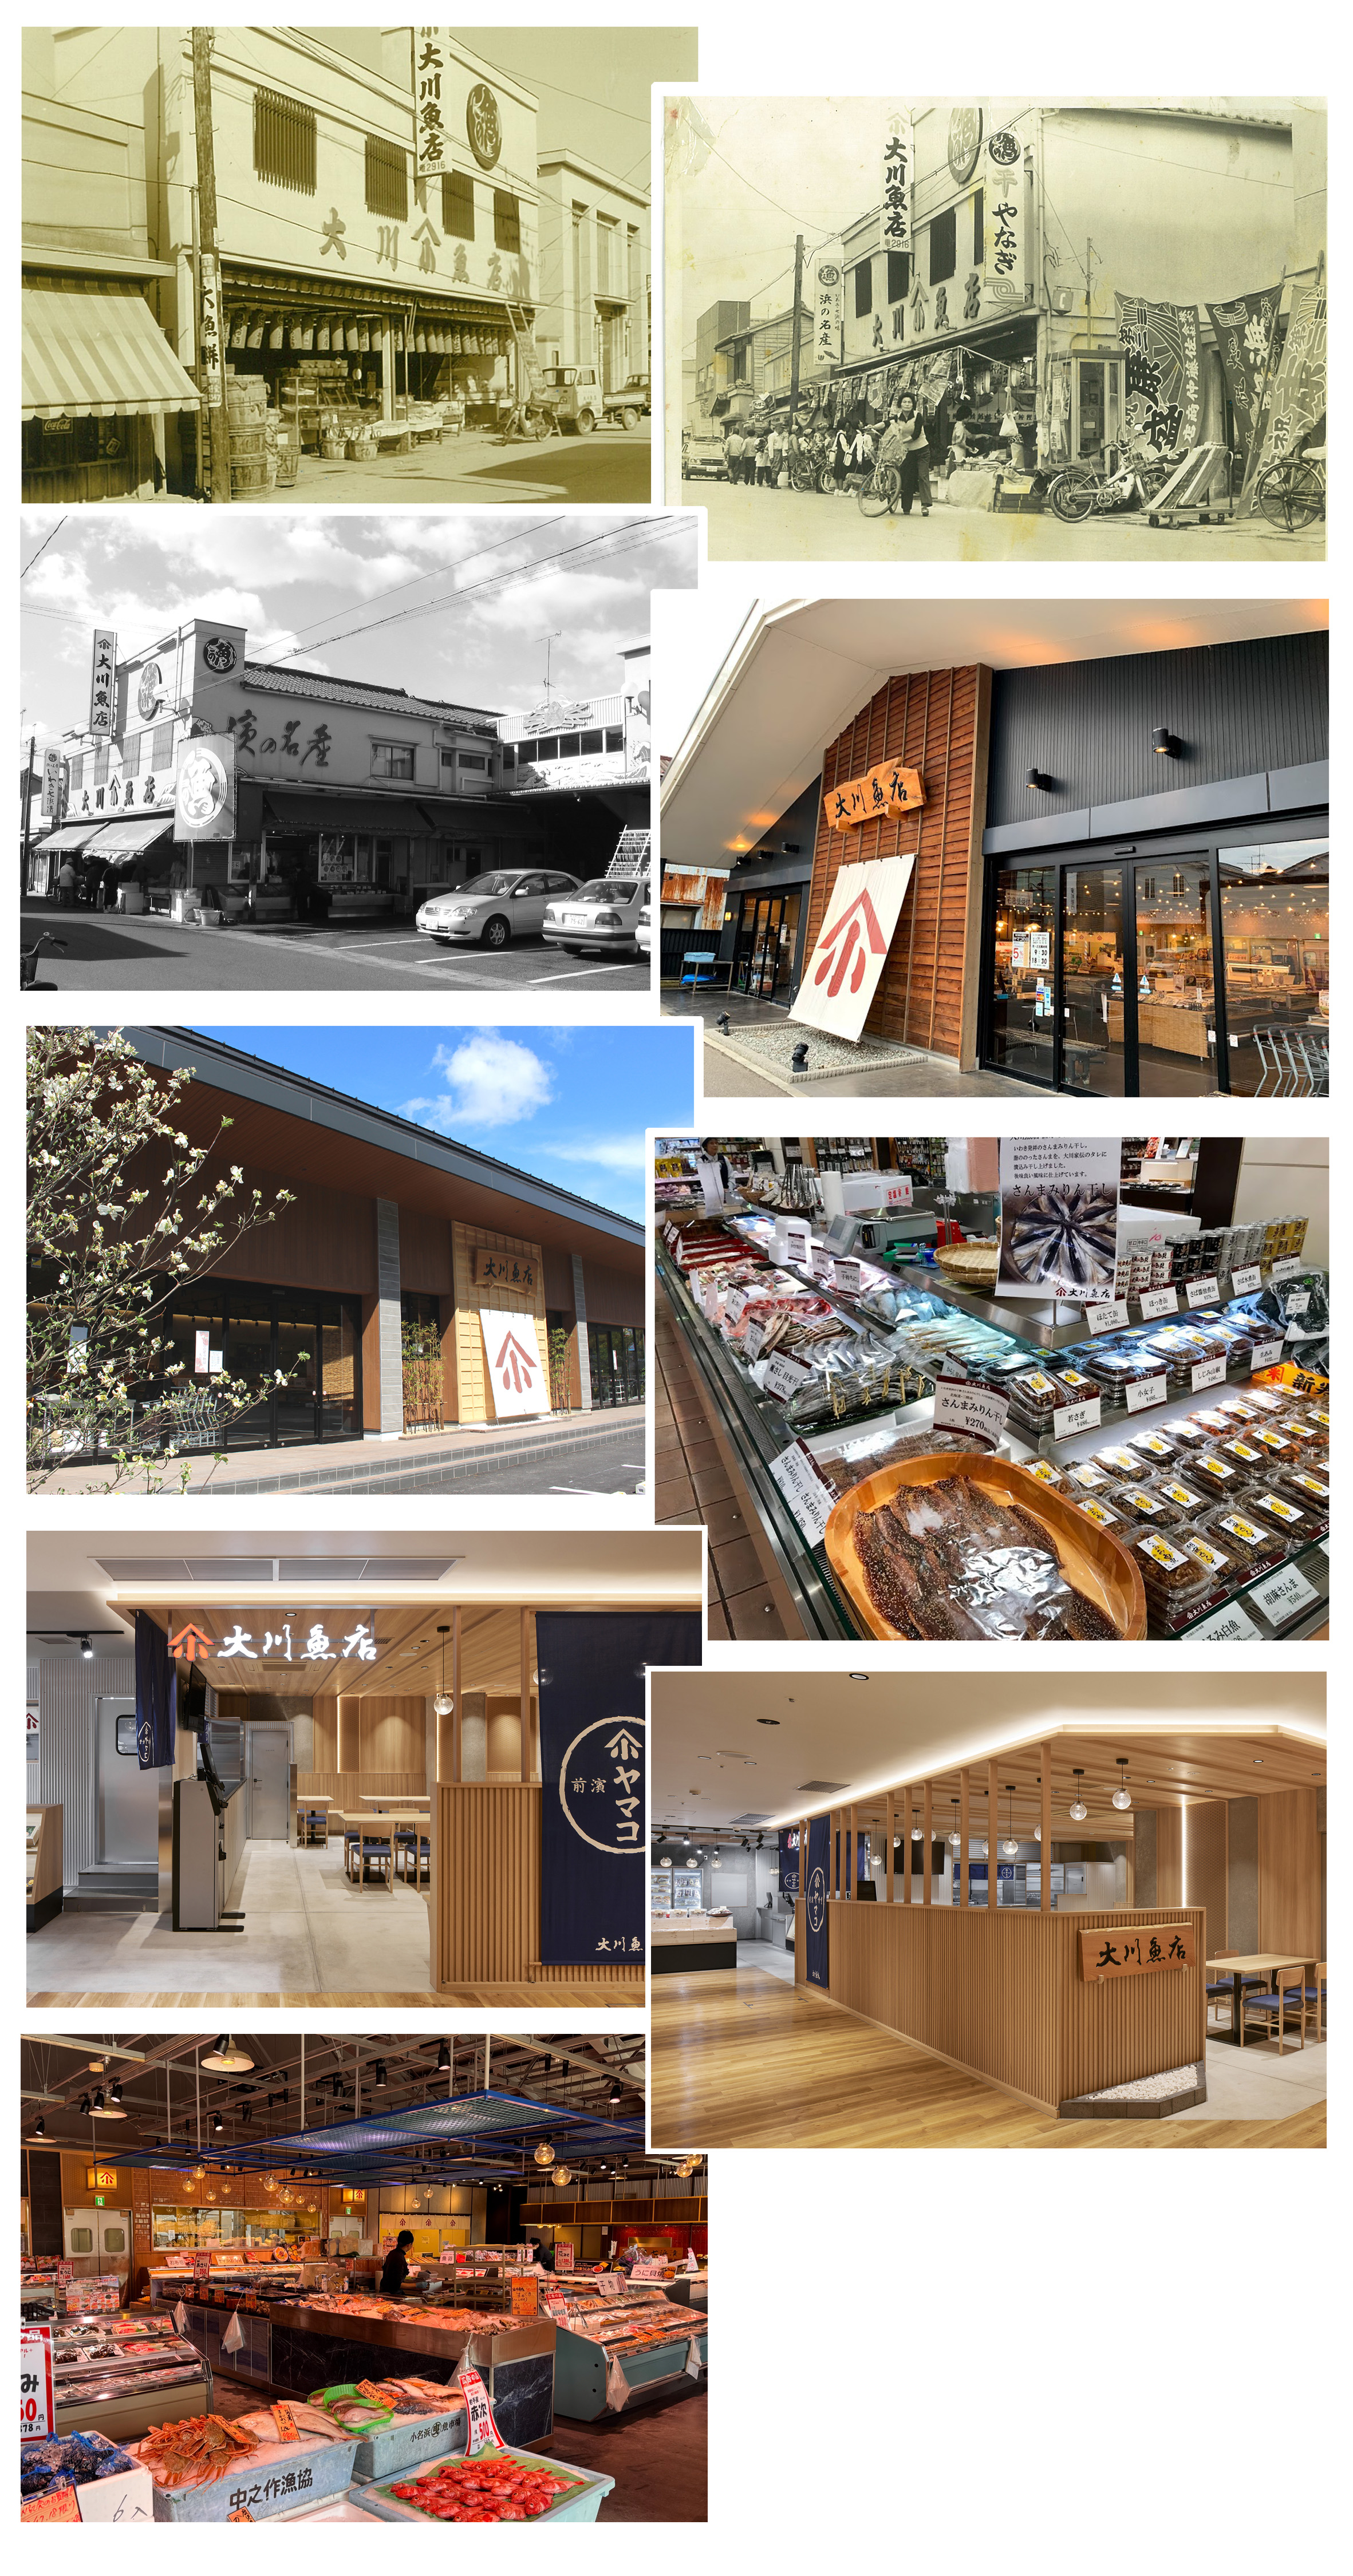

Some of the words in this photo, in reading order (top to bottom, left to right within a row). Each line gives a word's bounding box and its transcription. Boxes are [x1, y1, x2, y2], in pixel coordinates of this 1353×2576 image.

[417, 42, 444, 161] 大川魚店
[884, 137, 908, 238] 大川魚店
[885, 238, 909, 248] 電2916
[819, 294, 832, 346] 浜の名産
[93, 654, 112, 726] 大川魚店
[834, 772, 909, 820] 大川魚店
[1013, 1143, 1087, 1151] いわき発祥のさんまみりん干し。
[1013, 1183, 1113, 1197] さんまみりん干し
[483, 1257, 532, 1286] 大川魚店
[1068, 1288, 1111, 1298] 大川魚店
[1149, 1297, 1168, 1307] ほっき缶
[1096, 1310, 1118, 1321] ほたて缶
[1198, 1366, 1221, 1379] しじみ山椒
[972, 1381, 991, 1391] 大川魚店
[1138, 1386, 1154, 1397] 小女子
[941, 1397, 1003, 1425] さんまみりん干し
[1067, 1411, 1086, 1423] 若さぎ
[965, 1416, 984, 1430] ¥270
[782, 1456, 804, 1492] さんまみりん干し
[801, 1492, 826, 1534] さんまみりん干し
[1263, 1578, 1299, 1606] 胡麻さんま
[217, 1624, 377, 1661] 大川魚店
[571, 1777, 606, 1794] 前濱
[613, 1766, 641, 1842] ヤマコ
[595, 1937, 644, 1953] 大川魚
[1096, 1935, 1186, 1967] 大川魚店
[461, 2373, 479, 2383] 広告の品
[471, 2403, 487, 2421] 赤次
[230, 2468, 313, 2510] 中之作漁協
